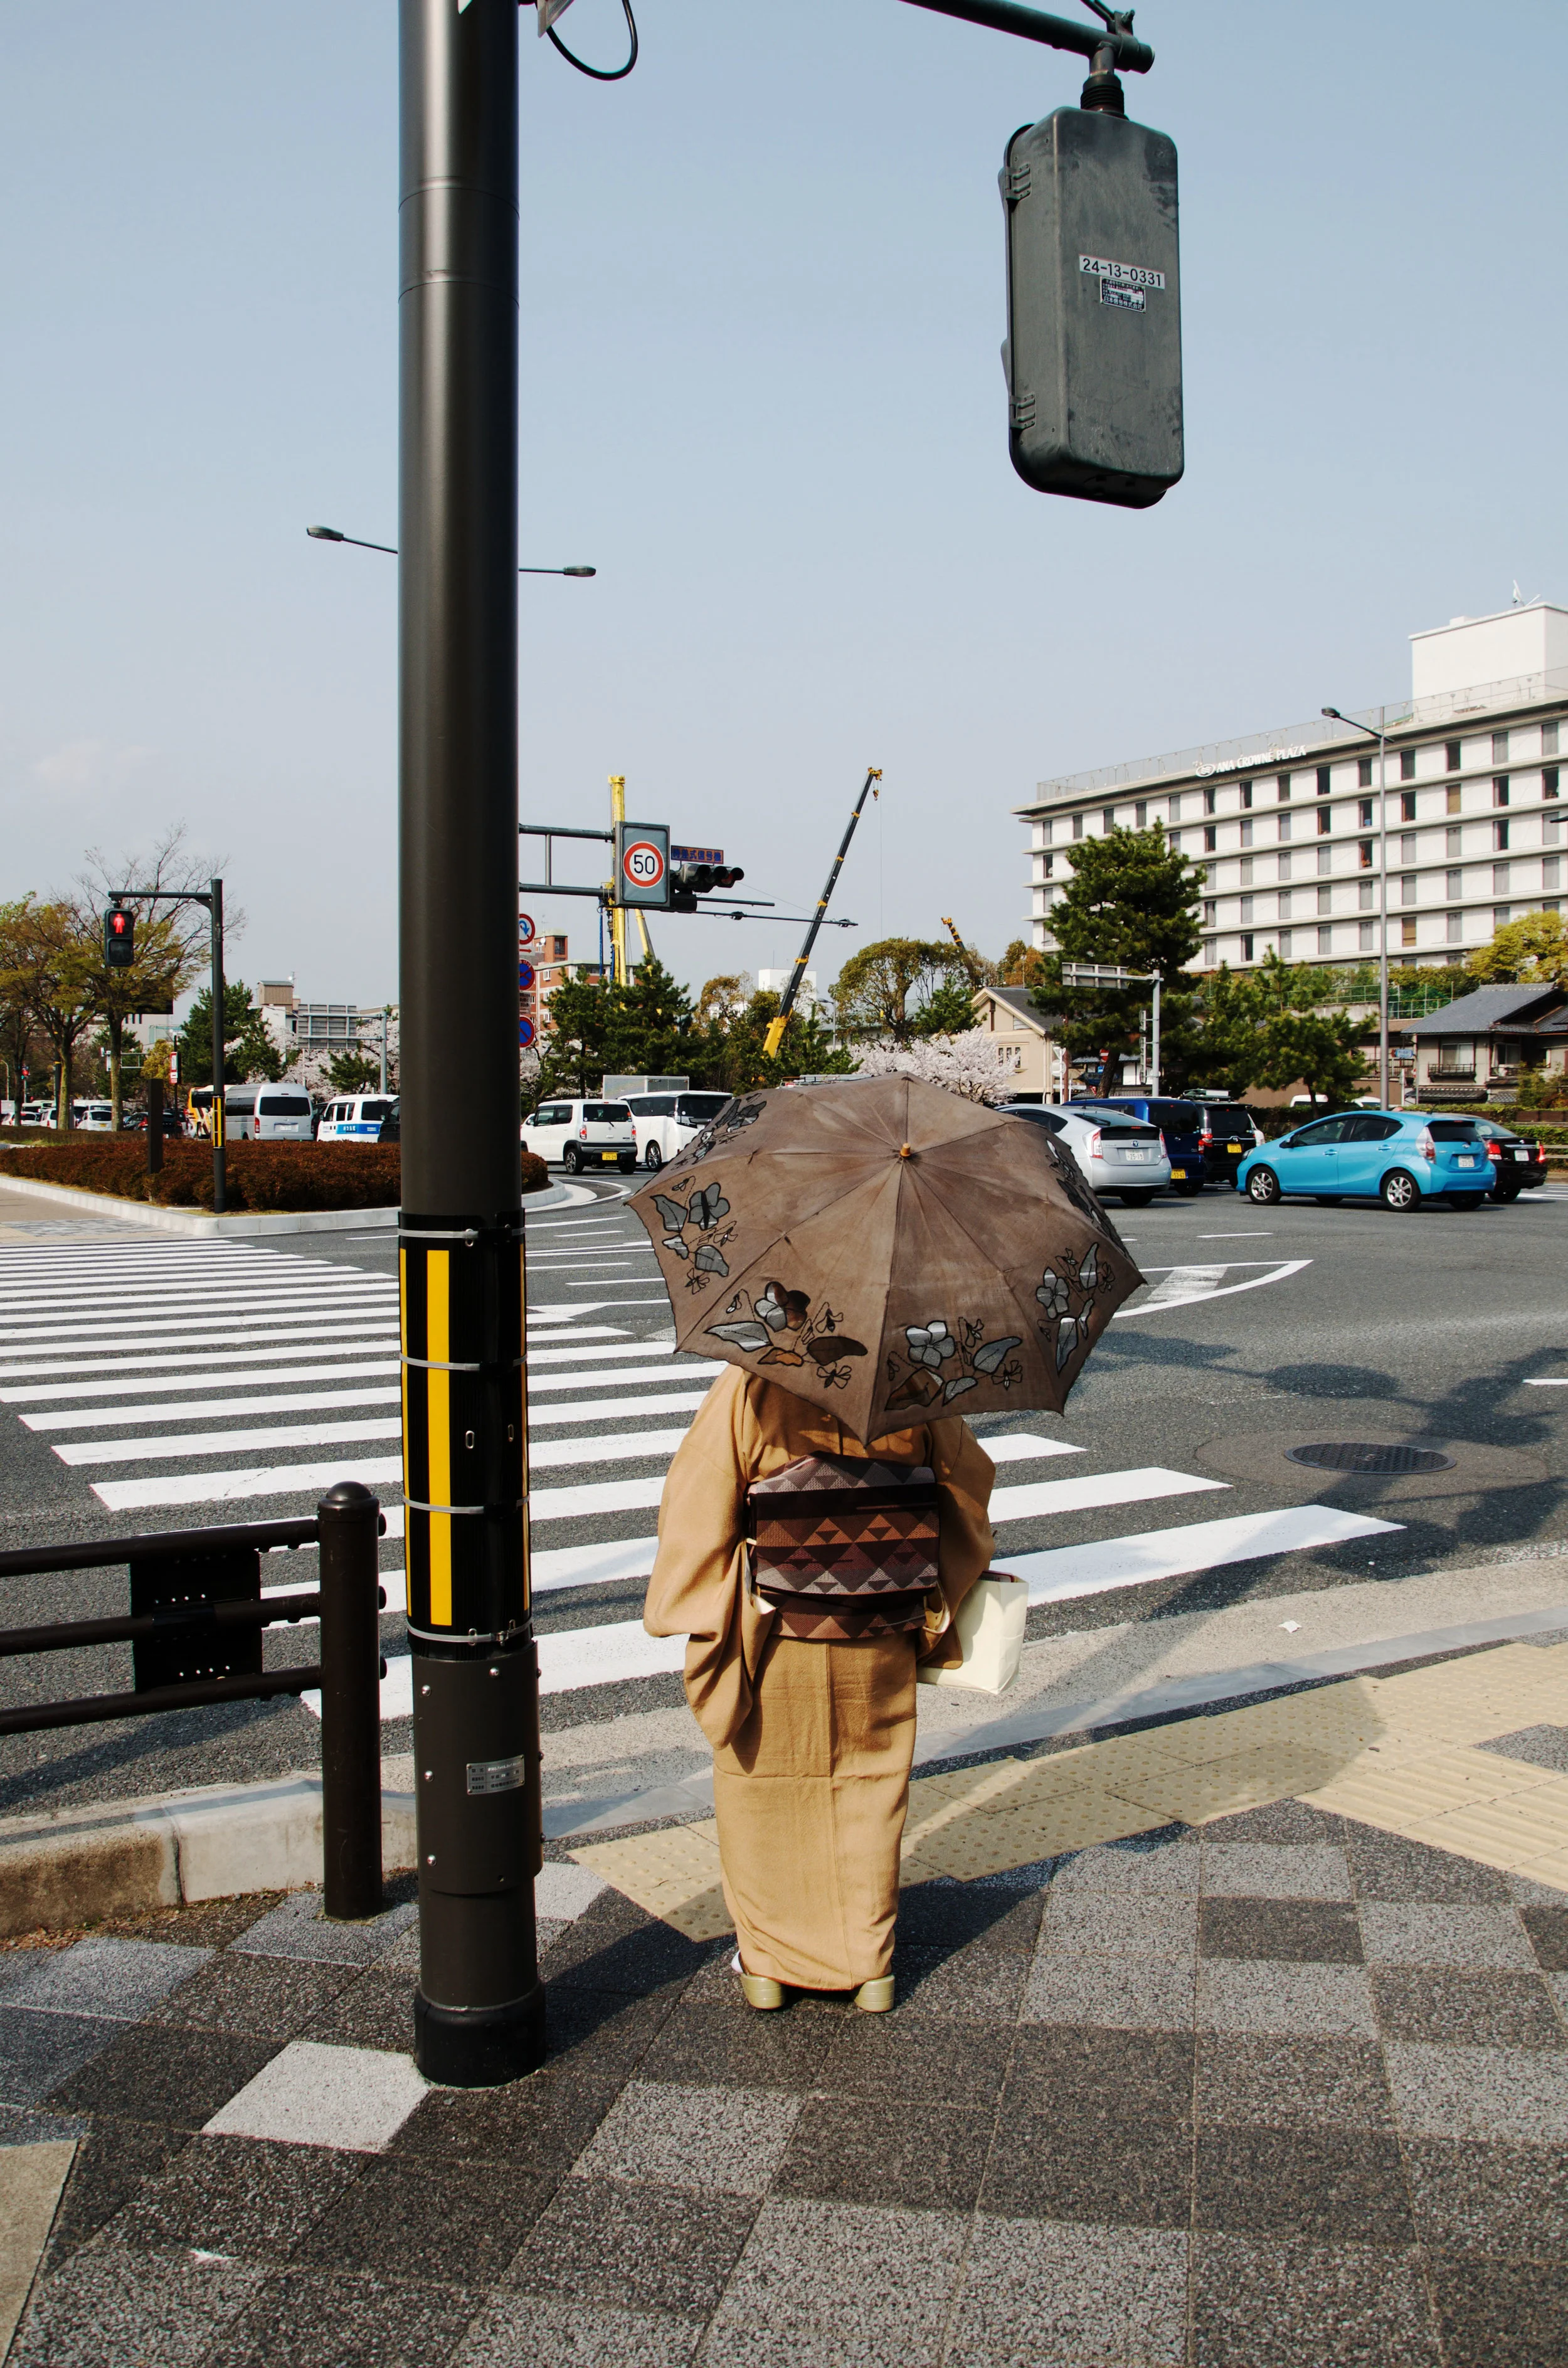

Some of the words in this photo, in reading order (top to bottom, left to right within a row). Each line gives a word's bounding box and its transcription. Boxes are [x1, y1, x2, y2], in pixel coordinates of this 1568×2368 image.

[1083, 258, 1161, 287] 24-13-0331
[1217, 760, 1236, 773] ANA
[1237, 751, 1274, 768] CROWNE
[1276, 745, 1306, 761] PLAZA
[633, 854, 655, 874] 50
